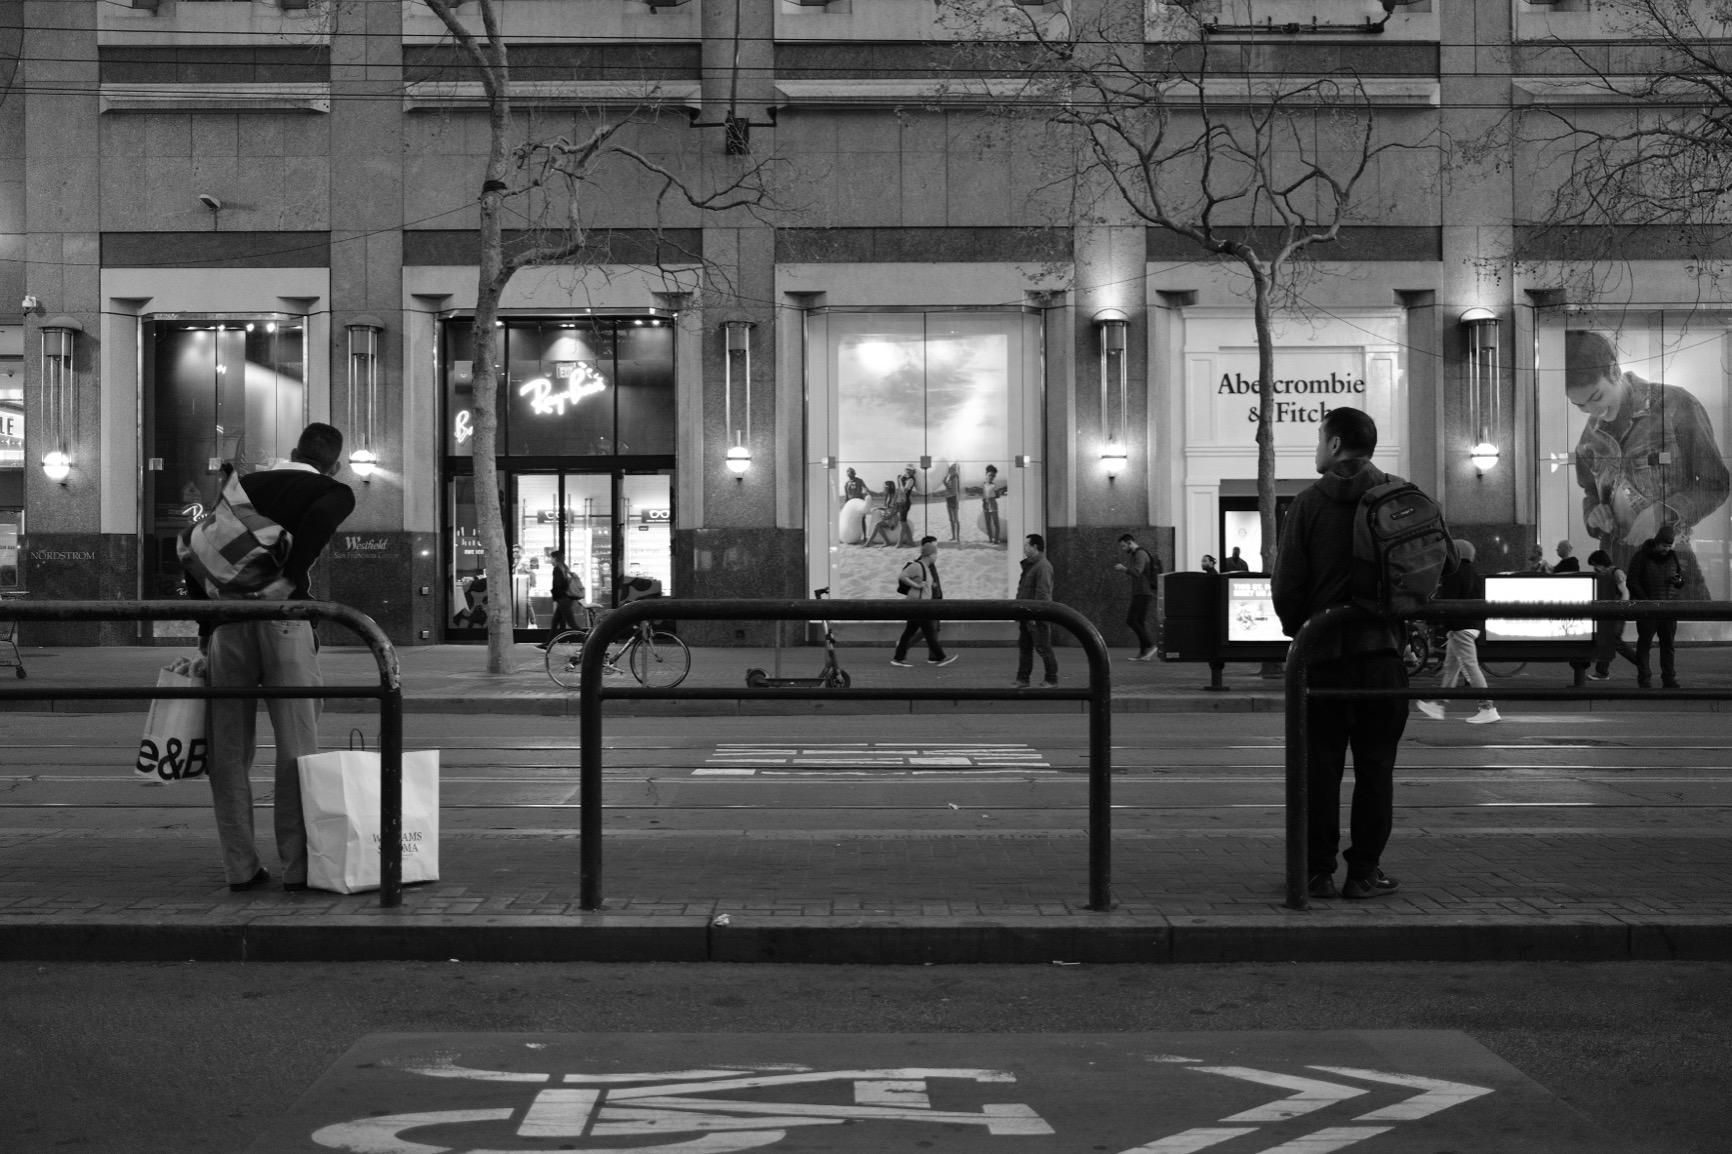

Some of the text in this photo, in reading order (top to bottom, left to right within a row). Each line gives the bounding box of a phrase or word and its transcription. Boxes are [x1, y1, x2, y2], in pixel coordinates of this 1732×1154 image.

[1217, 372, 1366, 395] Abecrombie
[1248, 406, 1262, 423] &
[345, 535, 389, 551] Westfield
[31, 551, 96, 561] NORDSTROM
[136, 737, 210, 781] e&B
[372, 831, 423, 842] WAMS
